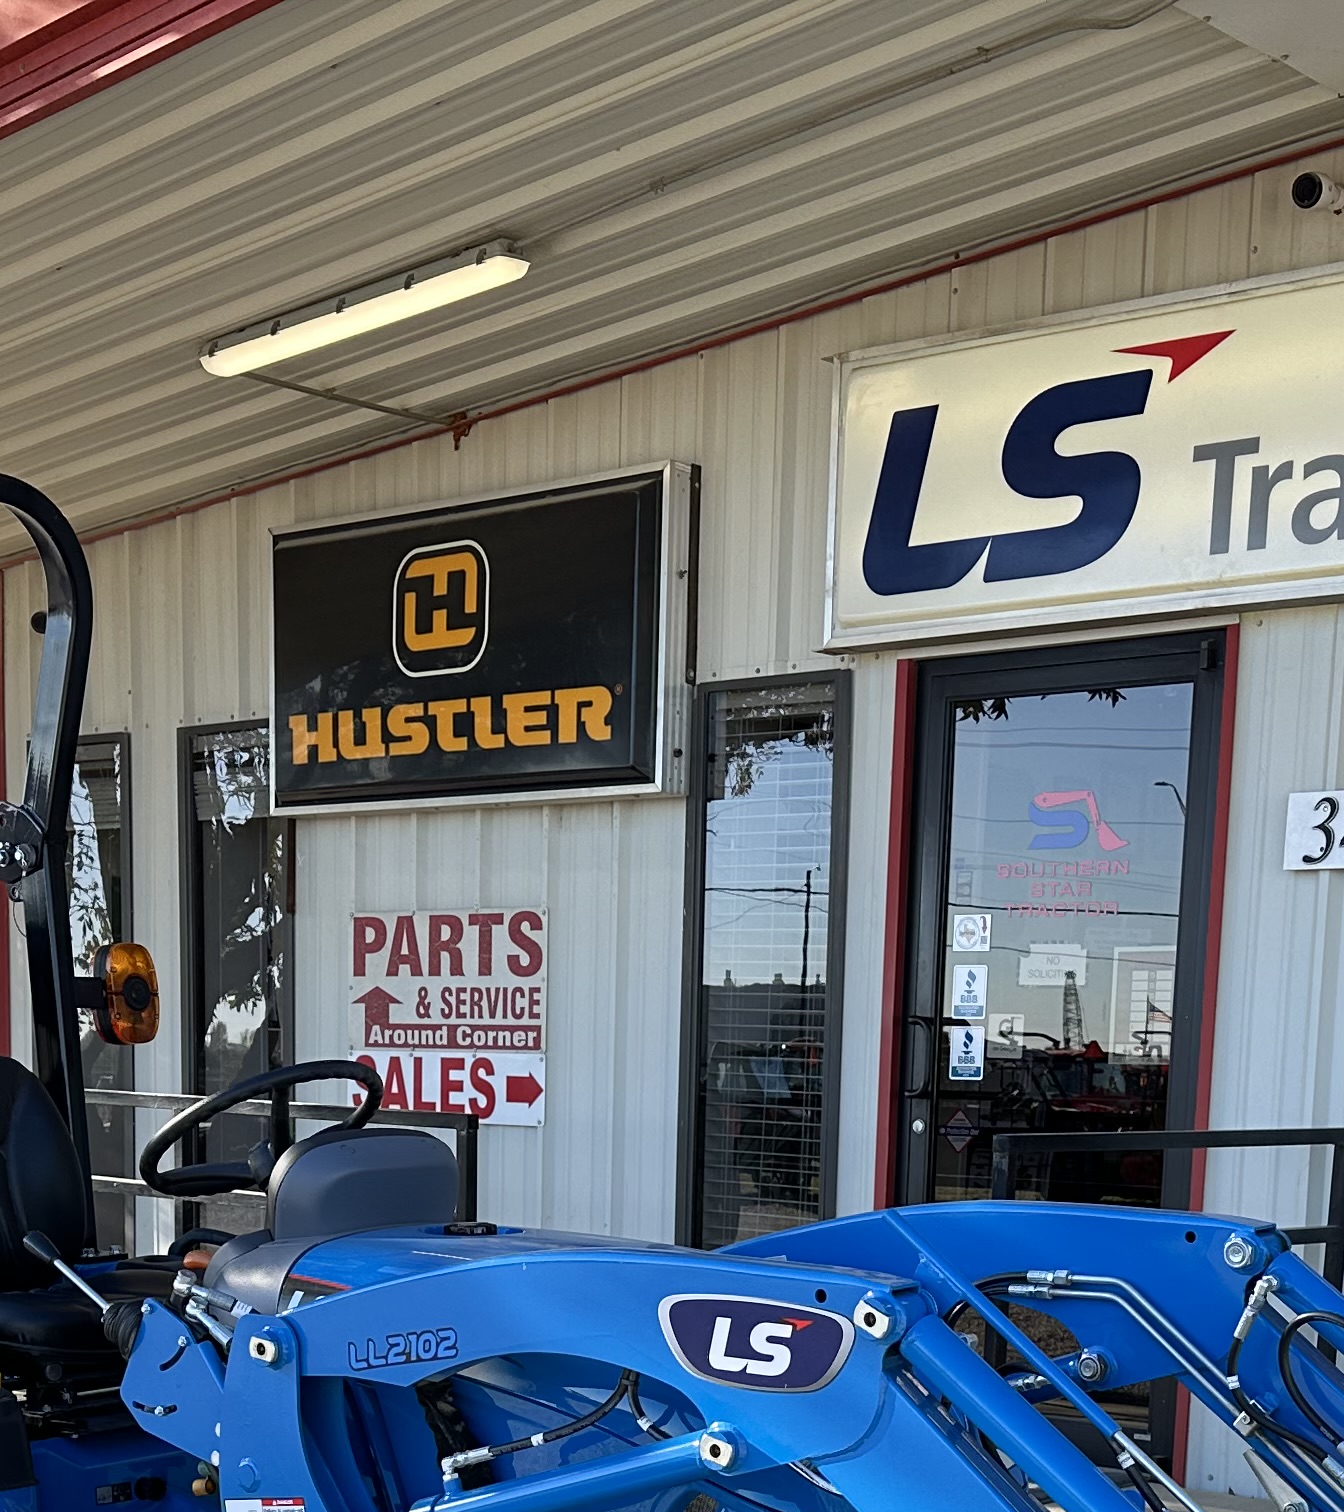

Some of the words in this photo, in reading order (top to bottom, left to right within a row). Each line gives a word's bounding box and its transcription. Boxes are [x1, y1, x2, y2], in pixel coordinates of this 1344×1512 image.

[862, 369, 1155, 597] LS
[288, 685, 613, 766] HUSTLER
[997, 860, 1130, 879] SOUTHERN
[1030, 881, 1093, 898] STAR
[1003, 901, 1120, 918] TRACTOR
[353, 911, 544, 977] PARTS
[1046, 956, 1061, 966] NO
[1028, 969, 1077, 979] SOLICITI
[415, 991, 433, 1018] &
[441, 985, 541, 1020] SERVICE
[368, 1026, 449, 1047] Around
[456, 1025, 538, 1048] Corner
[352, 1054, 496, 1119] SALES
[348, 1327, 459, 1371] LL2102
[708, 1316, 793, 1377] LS
